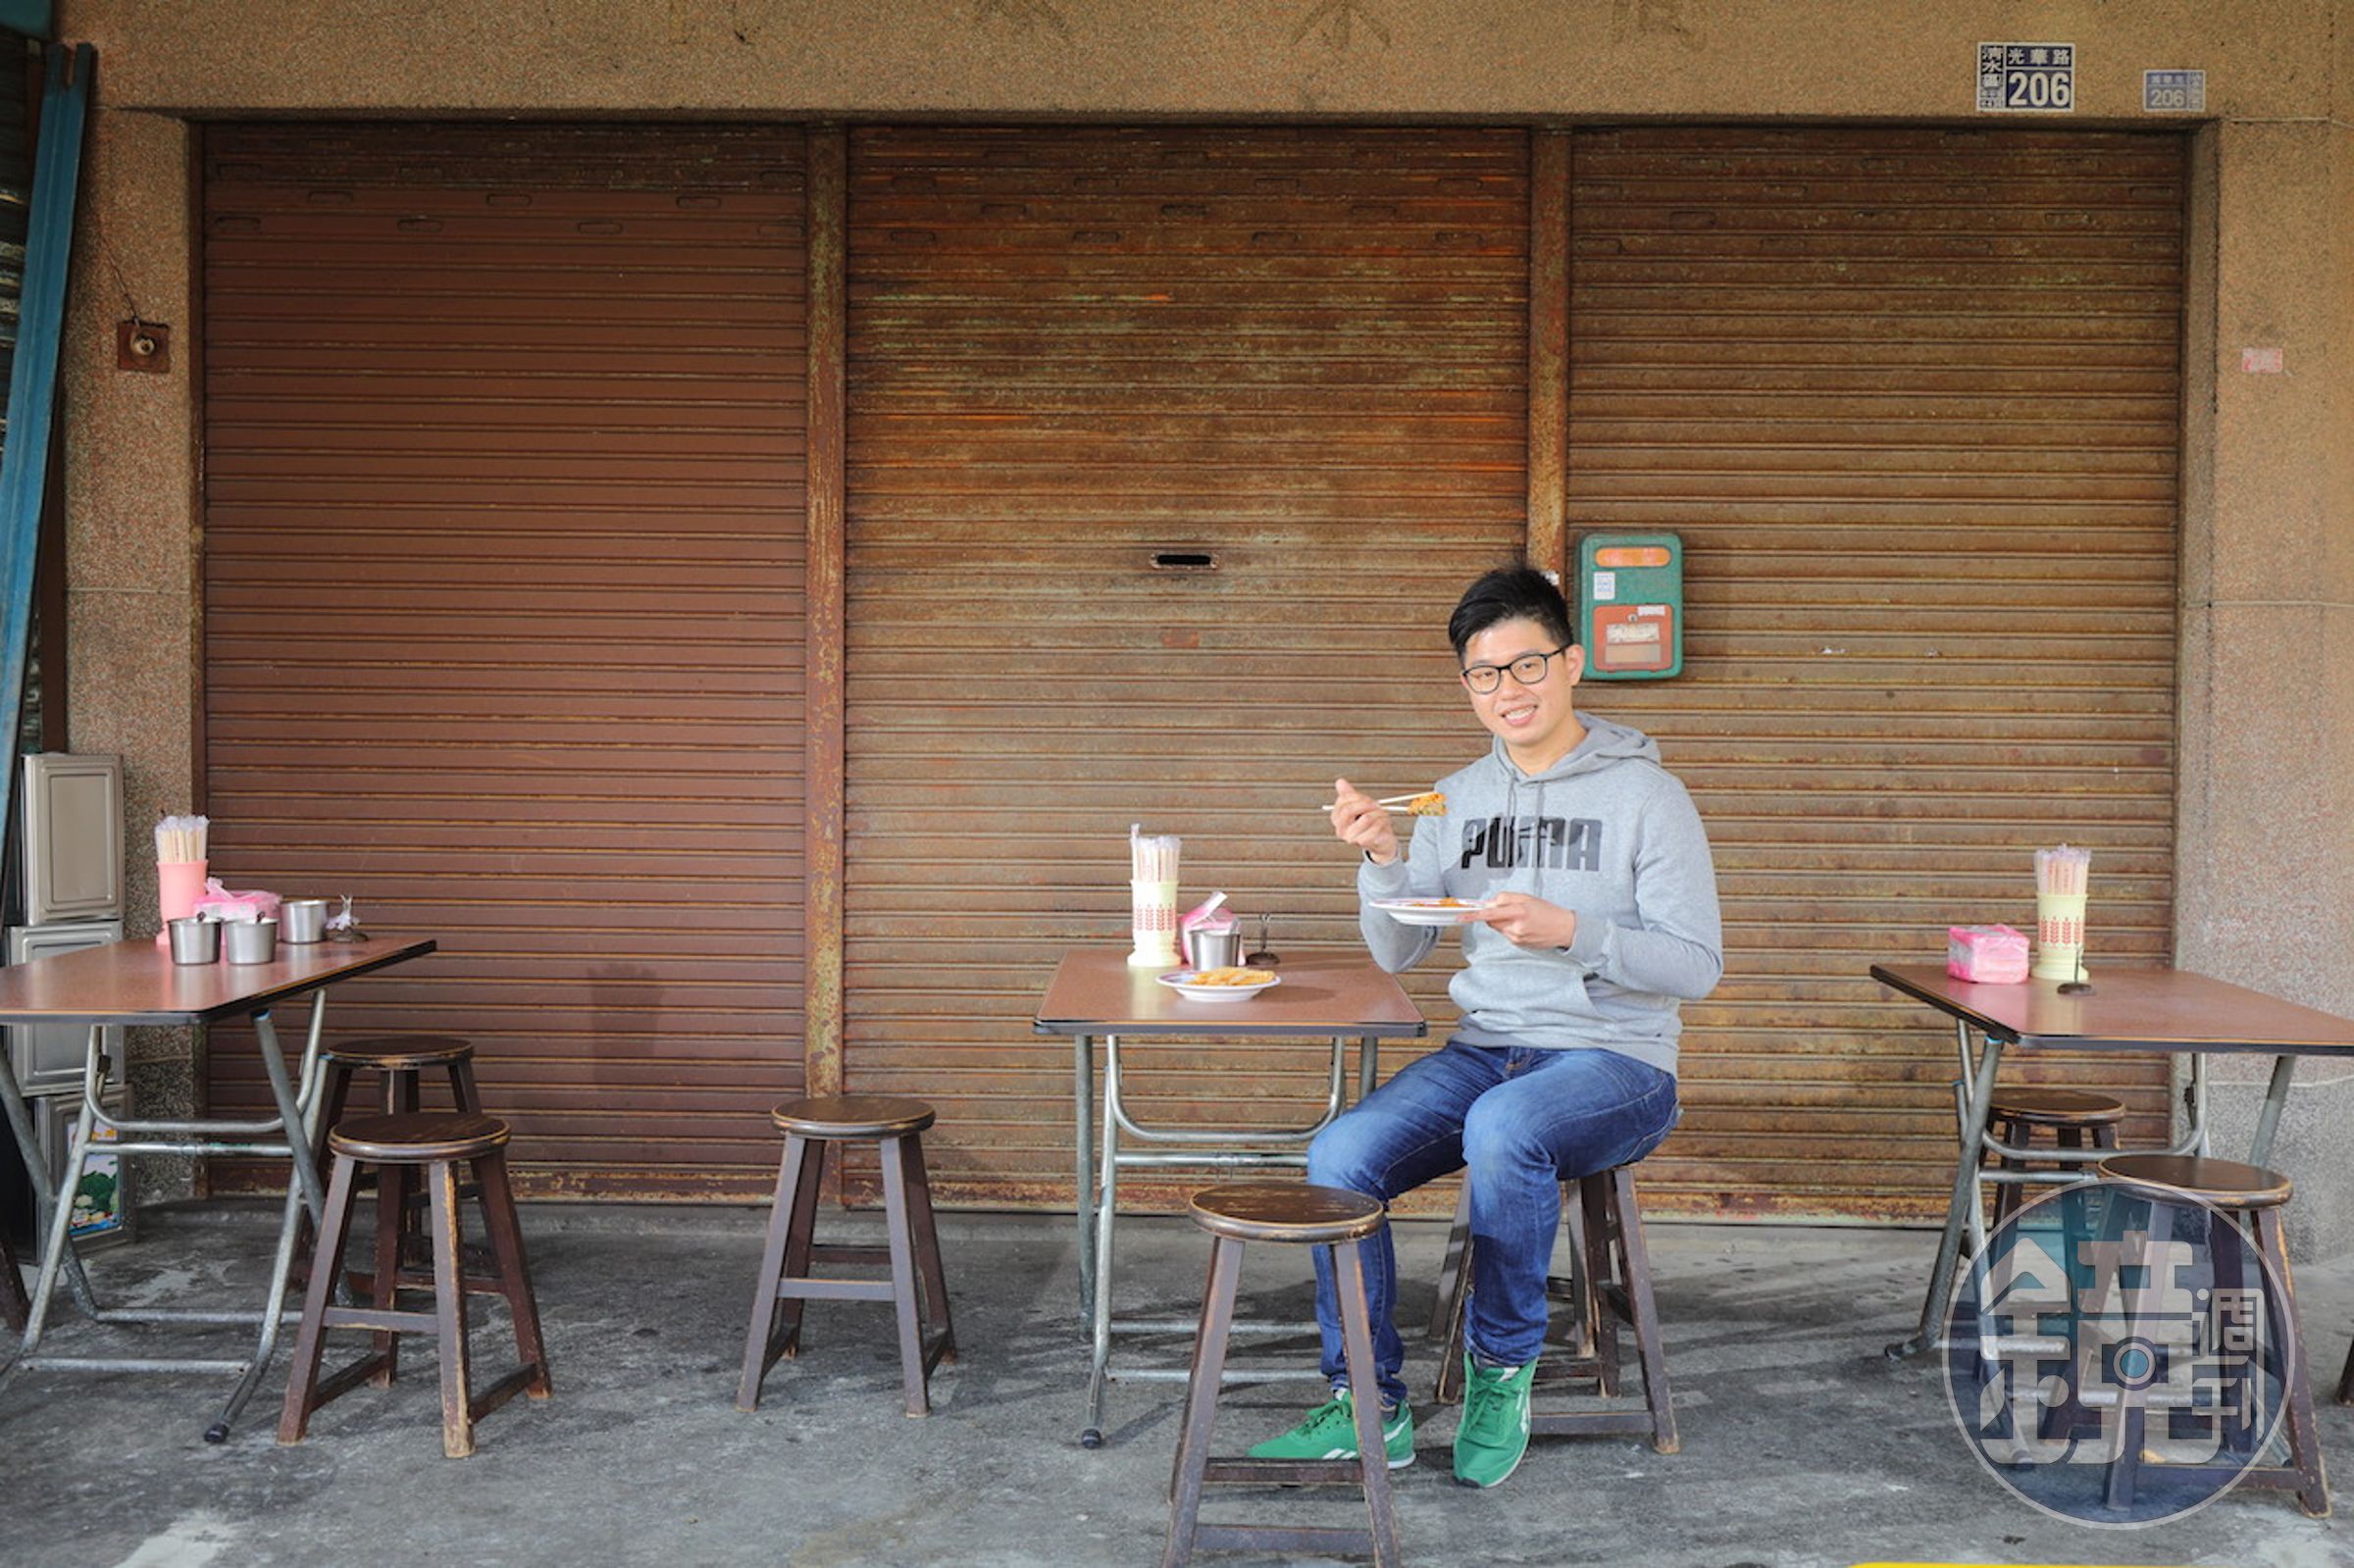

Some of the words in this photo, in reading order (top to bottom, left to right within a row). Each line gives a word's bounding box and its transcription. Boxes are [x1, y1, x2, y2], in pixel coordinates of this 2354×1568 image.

[2008, 48, 2070, 65] 光華路
[2009, 72, 2070, 106] 206
[2150, 89, 2185, 106] 206
[1461, 815, 1603, 872] PUMA
